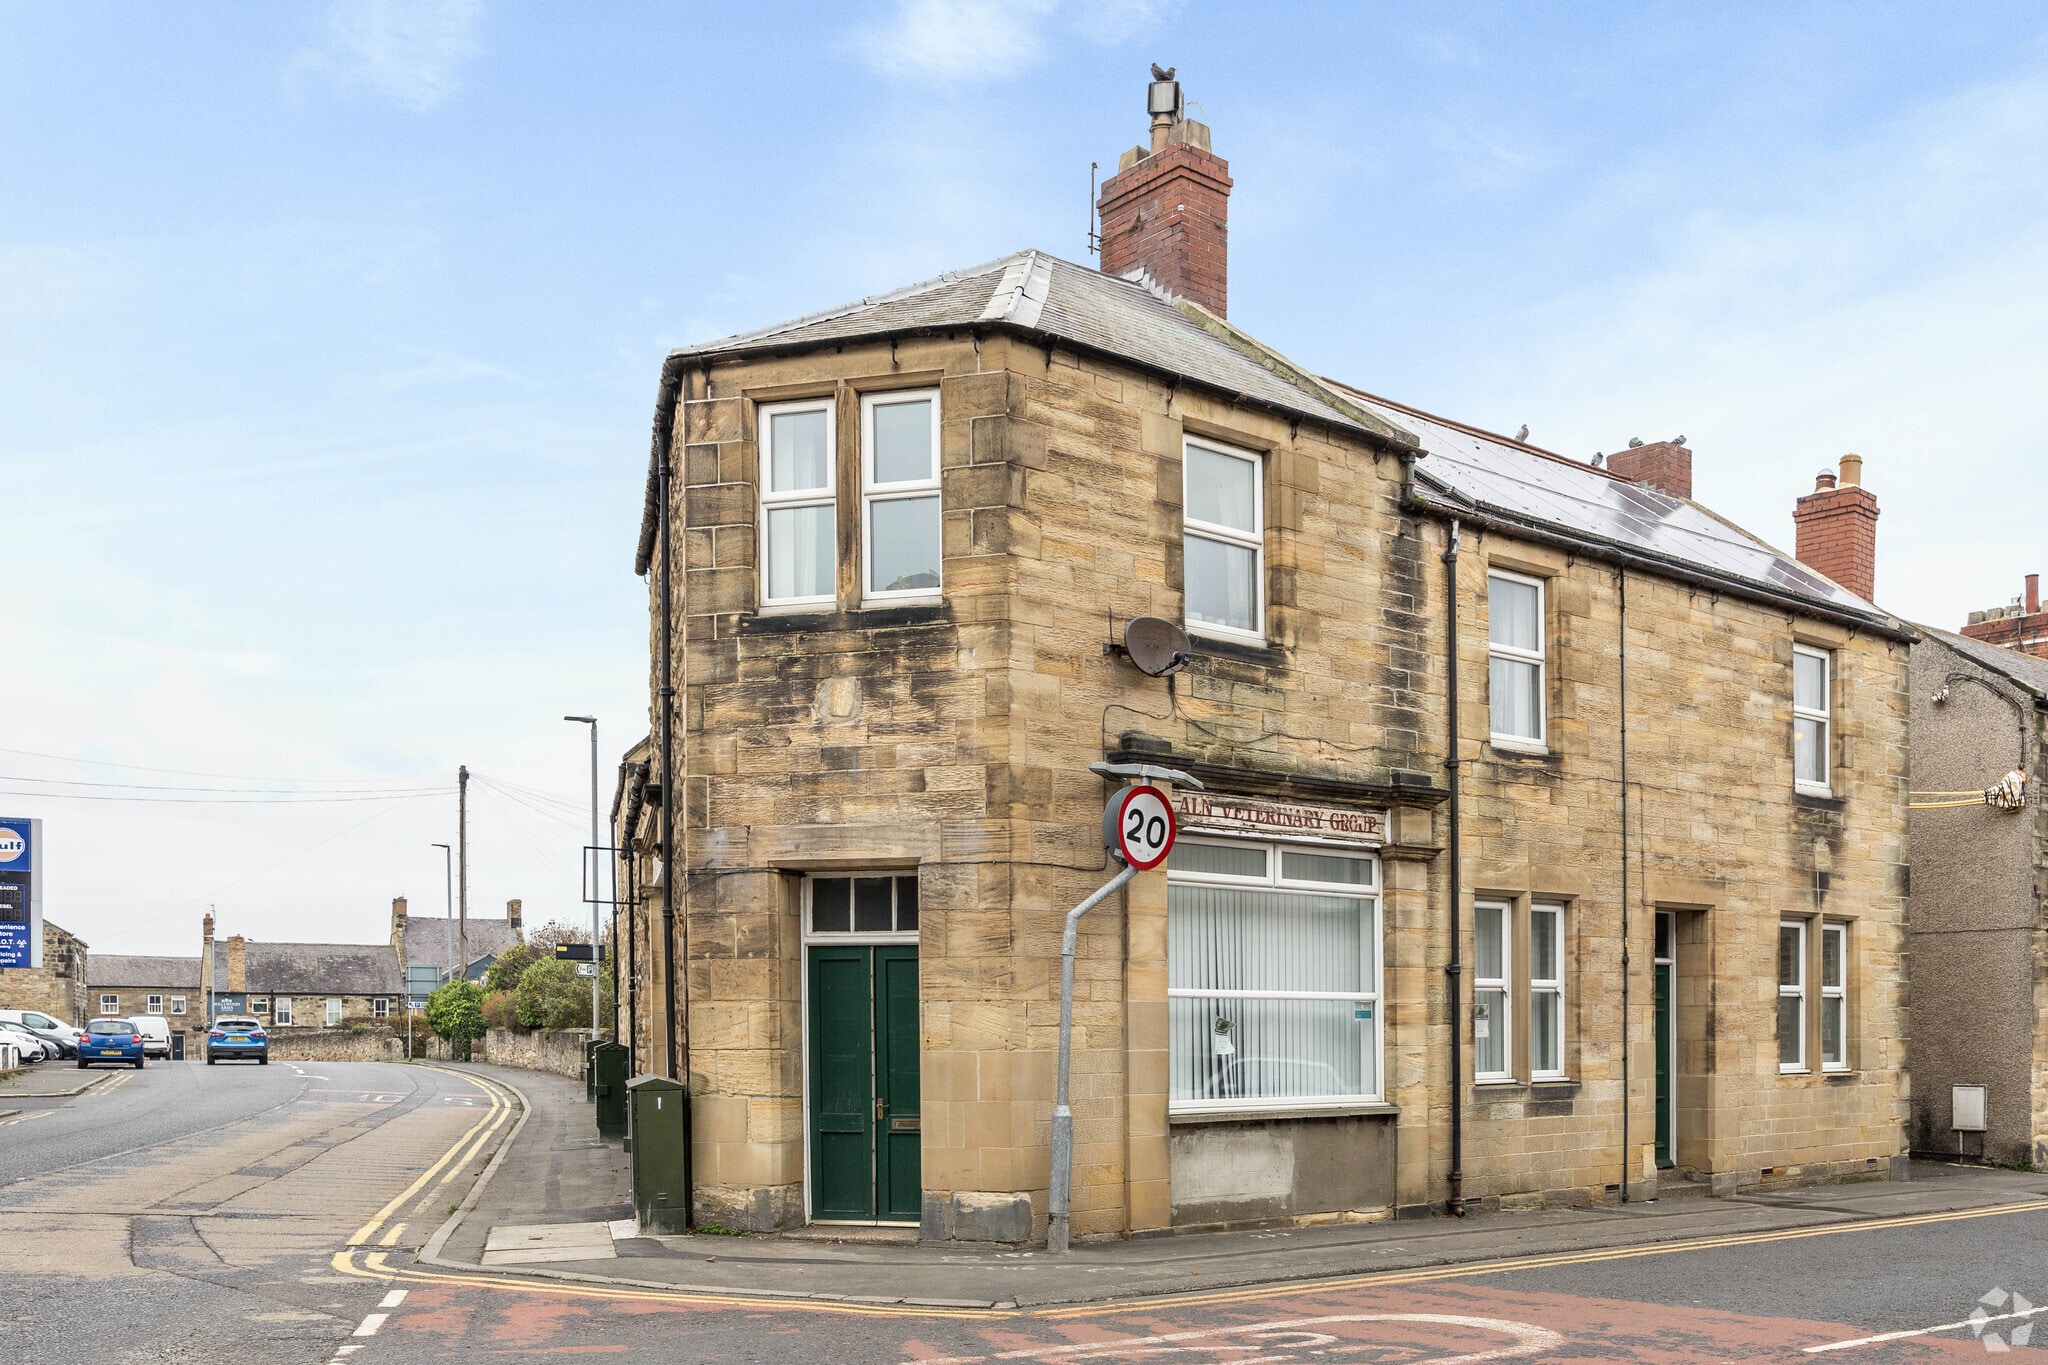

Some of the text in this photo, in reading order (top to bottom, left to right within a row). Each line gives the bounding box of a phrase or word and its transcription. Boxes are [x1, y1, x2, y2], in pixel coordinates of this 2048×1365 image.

[1127, 808, 1166, 849] 20
[1180, 796, 1377, 833] ALN VETERINARY GROUP
[0, 841, 22, 850] ulf
